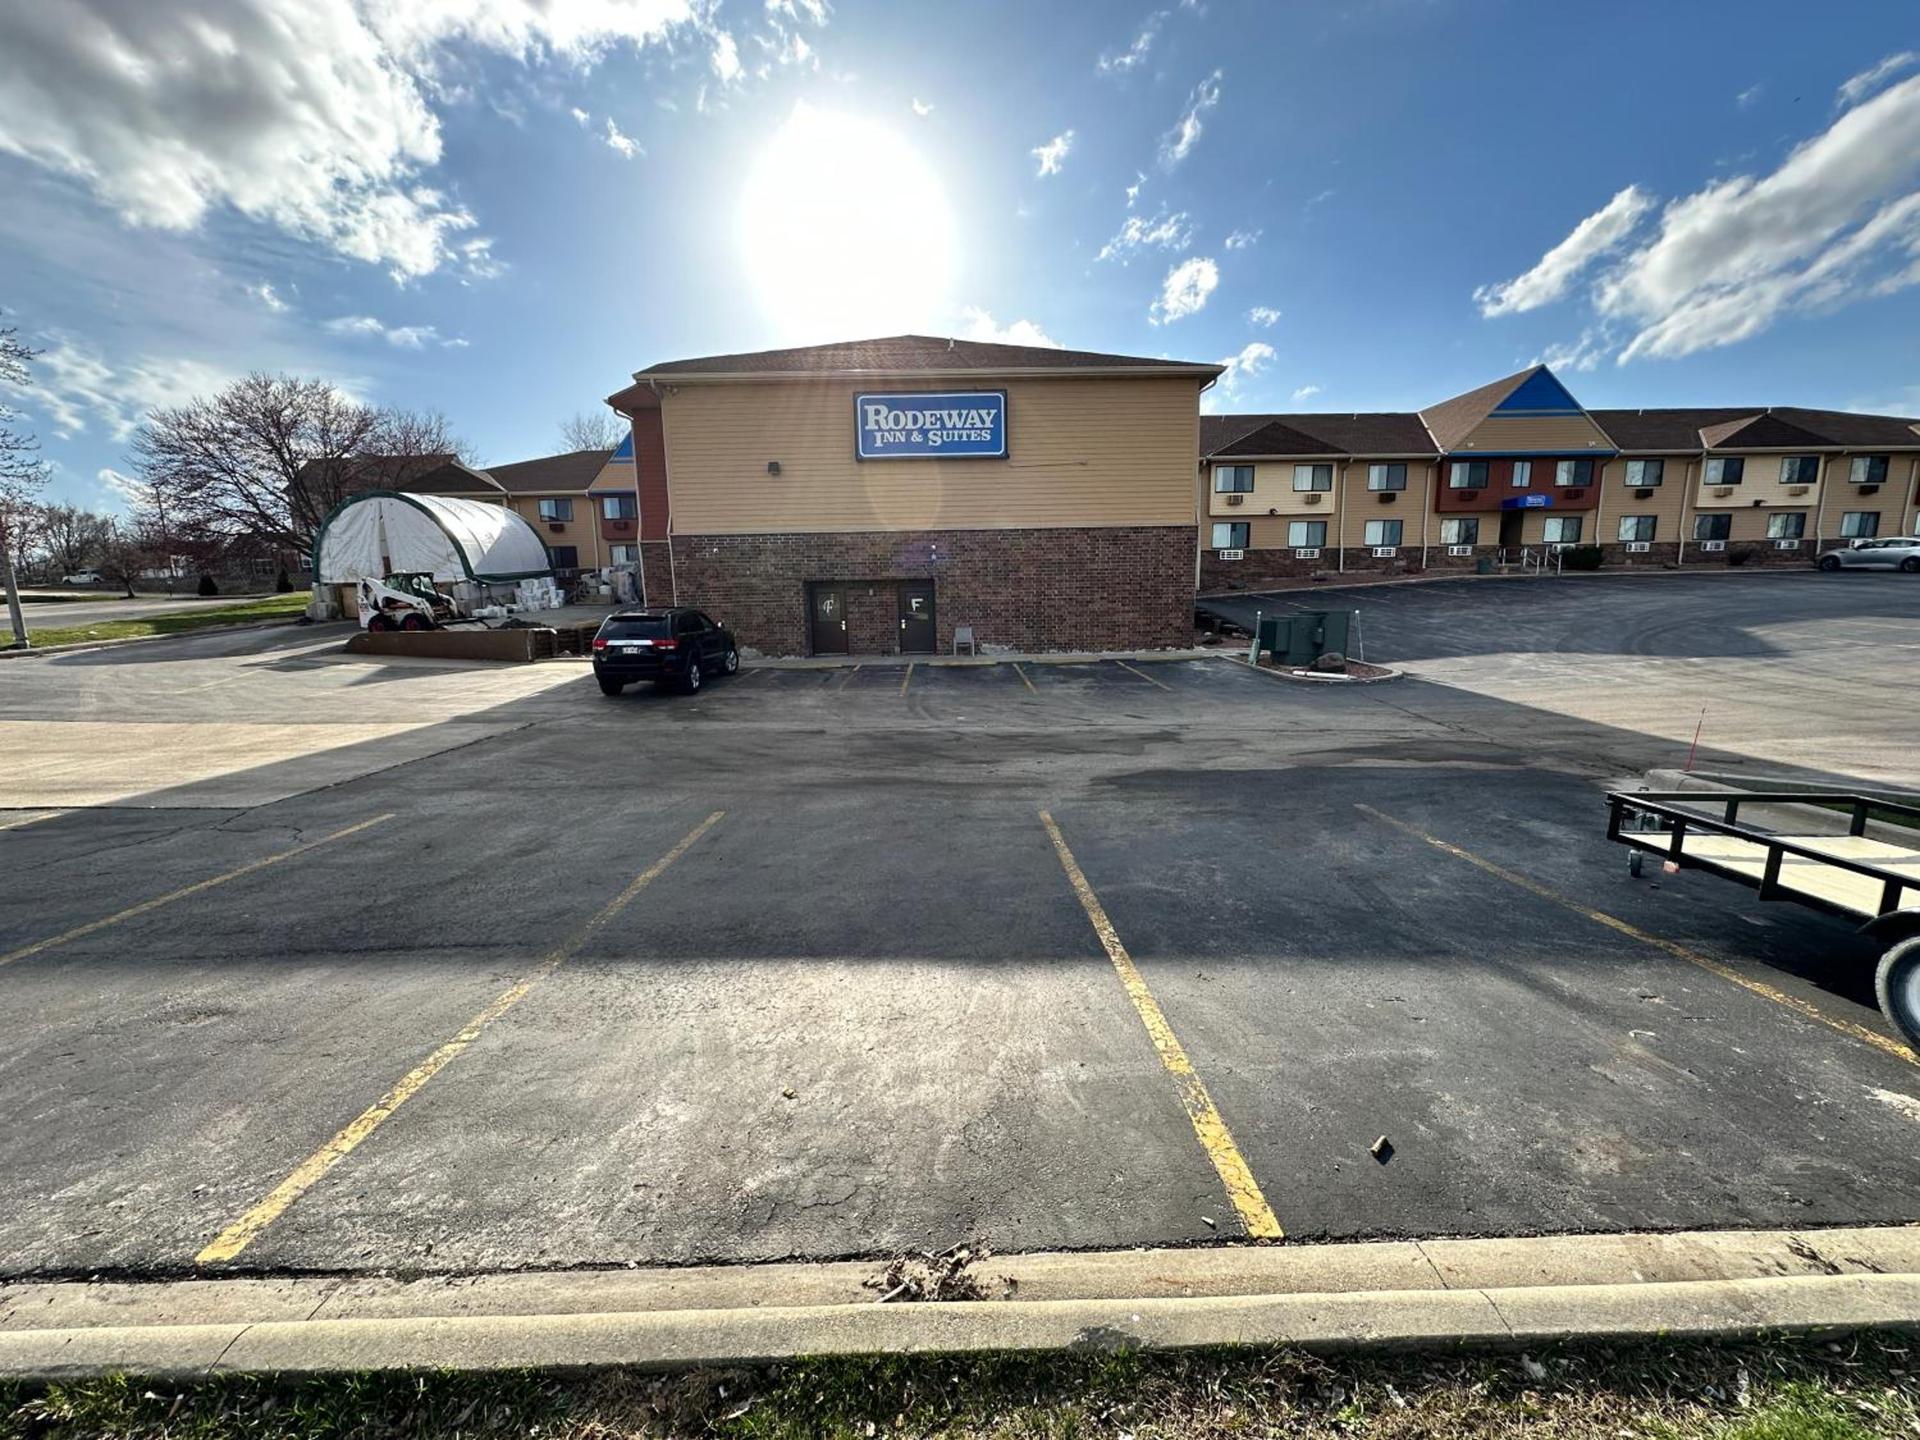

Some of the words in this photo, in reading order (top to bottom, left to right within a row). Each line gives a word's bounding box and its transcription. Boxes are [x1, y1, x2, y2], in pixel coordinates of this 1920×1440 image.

[864, 405, 997, 430] RODEWAY
[874, 431, 906, 447] INN
[911, 431, 923, 442] &
[928, 430, 991, 446] SUITES
[911, 598, 924, 611] F
